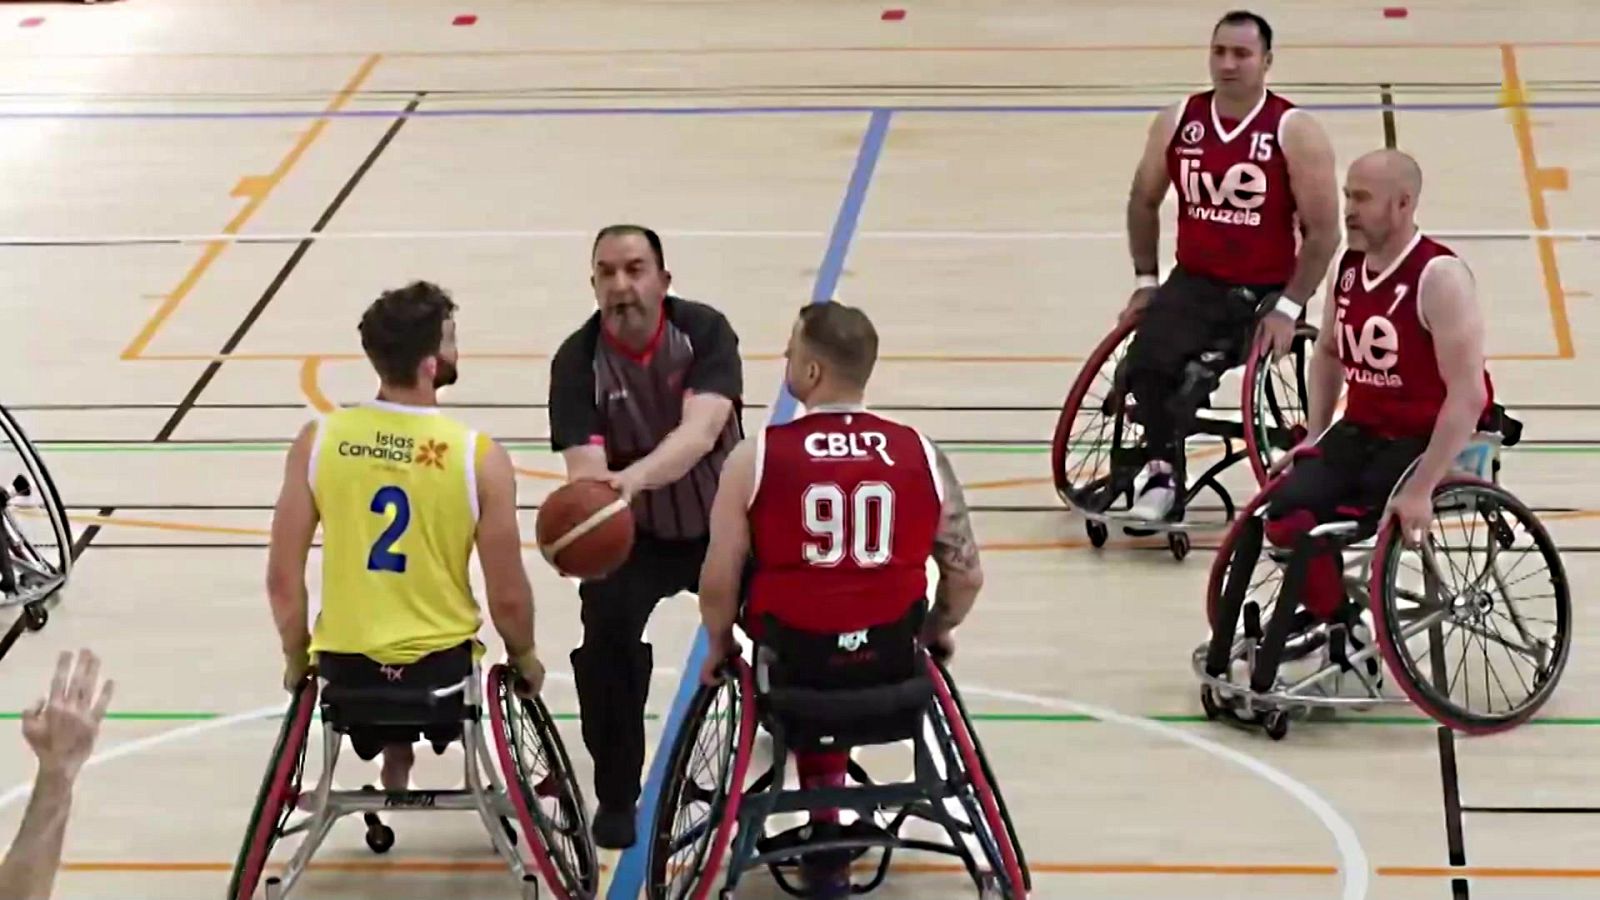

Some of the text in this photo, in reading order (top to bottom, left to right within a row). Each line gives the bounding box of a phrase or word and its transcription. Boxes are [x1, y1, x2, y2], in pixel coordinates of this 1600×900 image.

[1249, 132, 1274, 161] 15
[1180, 159, 1267, 209] live
[1387, 284, 1408, 316] 7
[338, 441, 413, 463] Canarias
[376, 431, 414, 448] Islas
[367, 485, 411, 573] 2
[801, 481, 896, 568] 90
